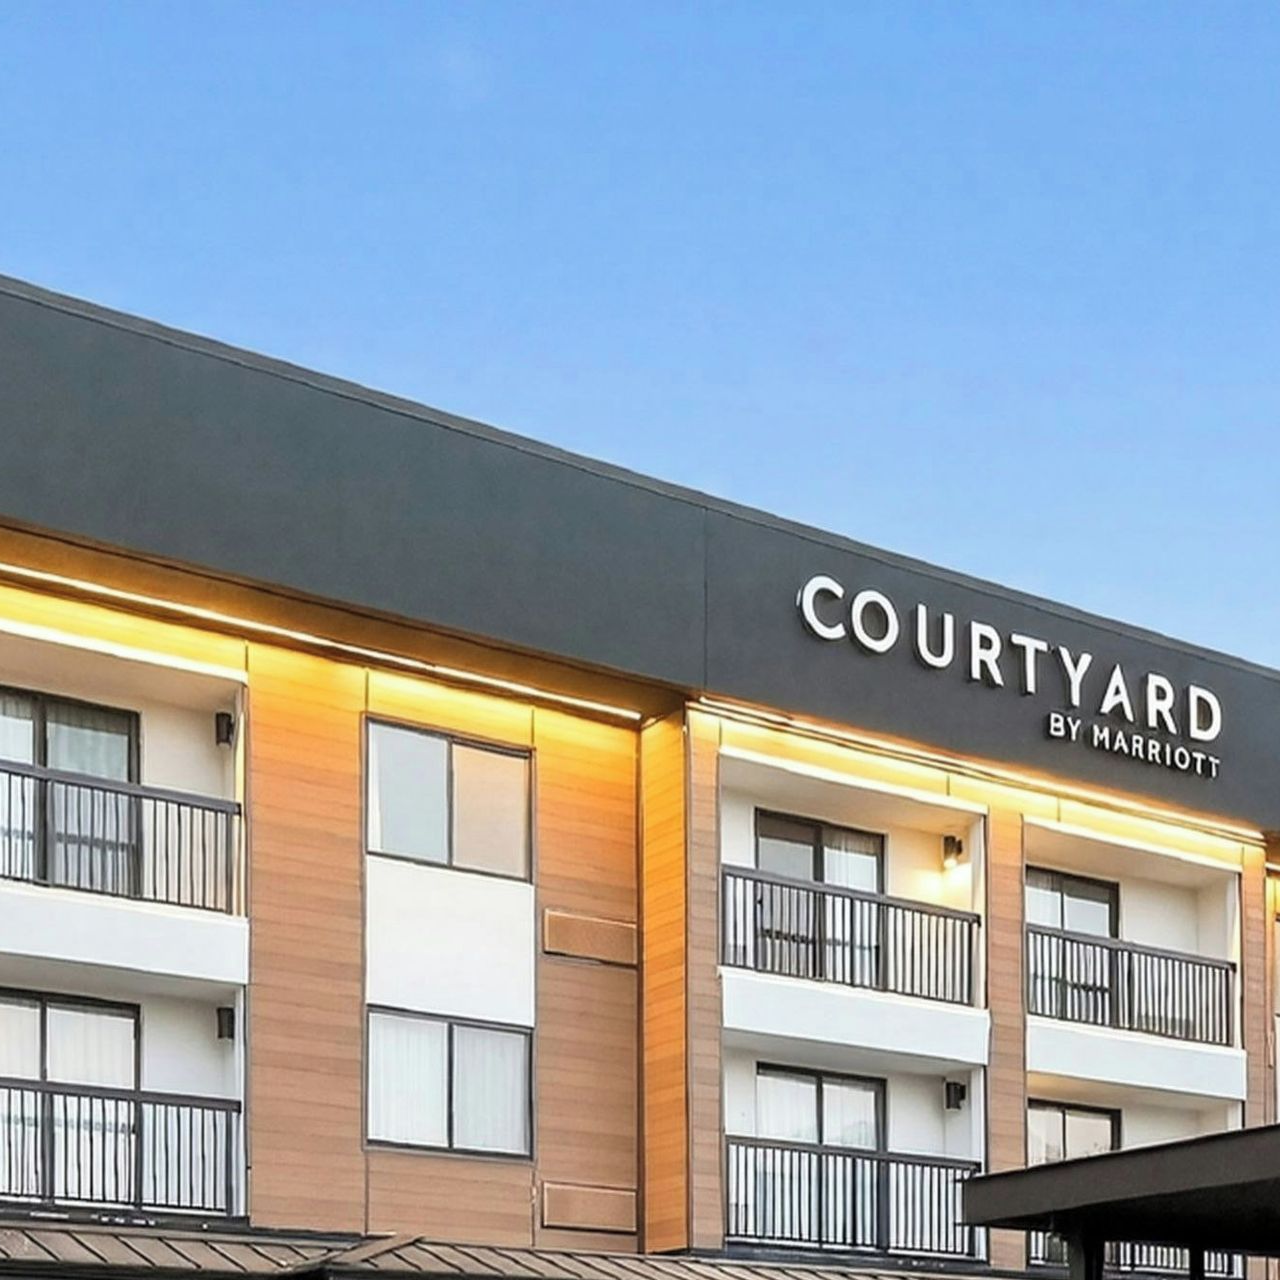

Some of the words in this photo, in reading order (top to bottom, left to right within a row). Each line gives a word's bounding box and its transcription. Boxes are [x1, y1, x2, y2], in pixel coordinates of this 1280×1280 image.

[798, 575, 1222, 742] COURTYARD
[1049, 713, 1081, 742] BY
[1092, 725, 1221, 778] MARRIOTT
